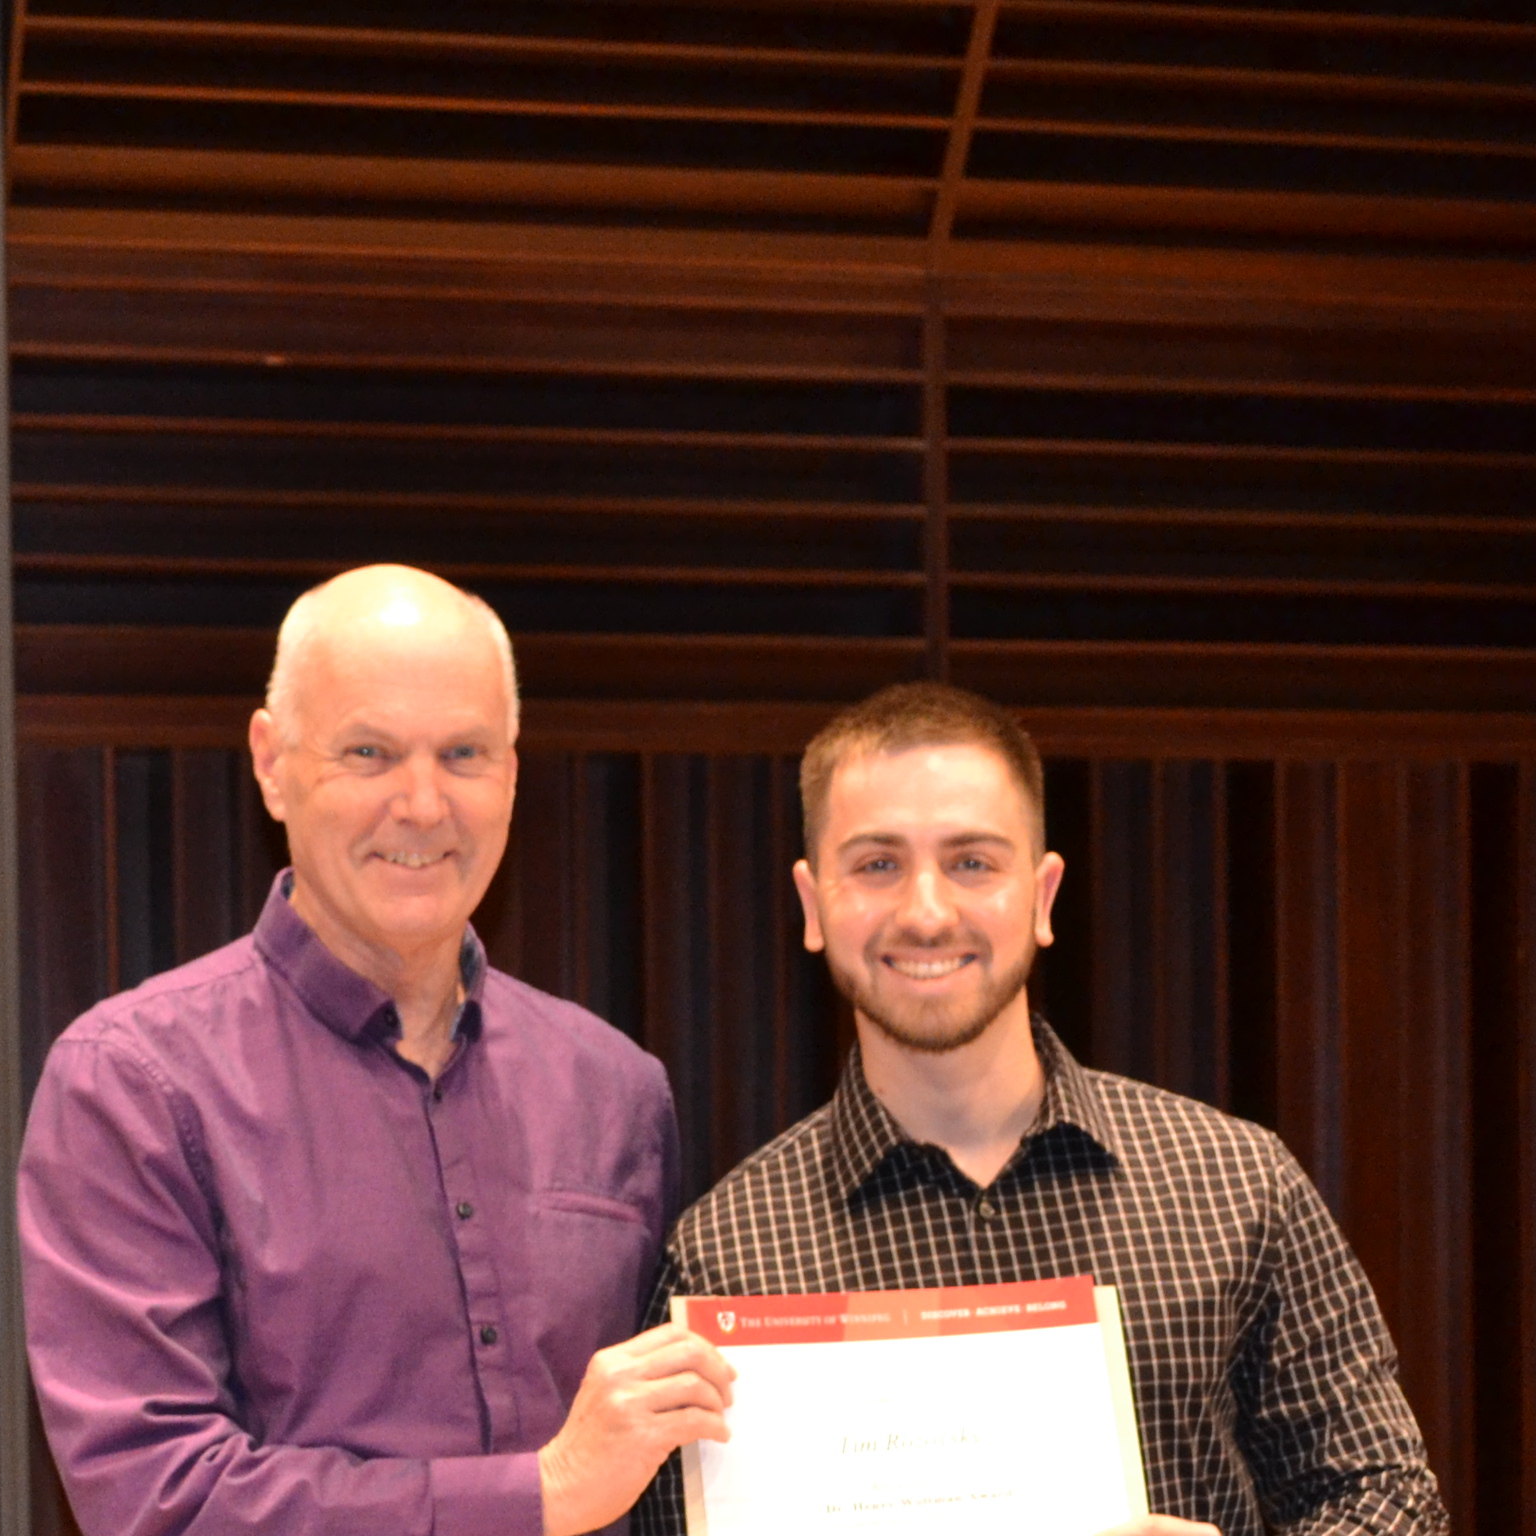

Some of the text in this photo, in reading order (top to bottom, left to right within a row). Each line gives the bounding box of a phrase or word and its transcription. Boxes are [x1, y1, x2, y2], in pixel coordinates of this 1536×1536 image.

[920, 1300, 1067, 1320] DISCOVER ACHIEVE BELONG
